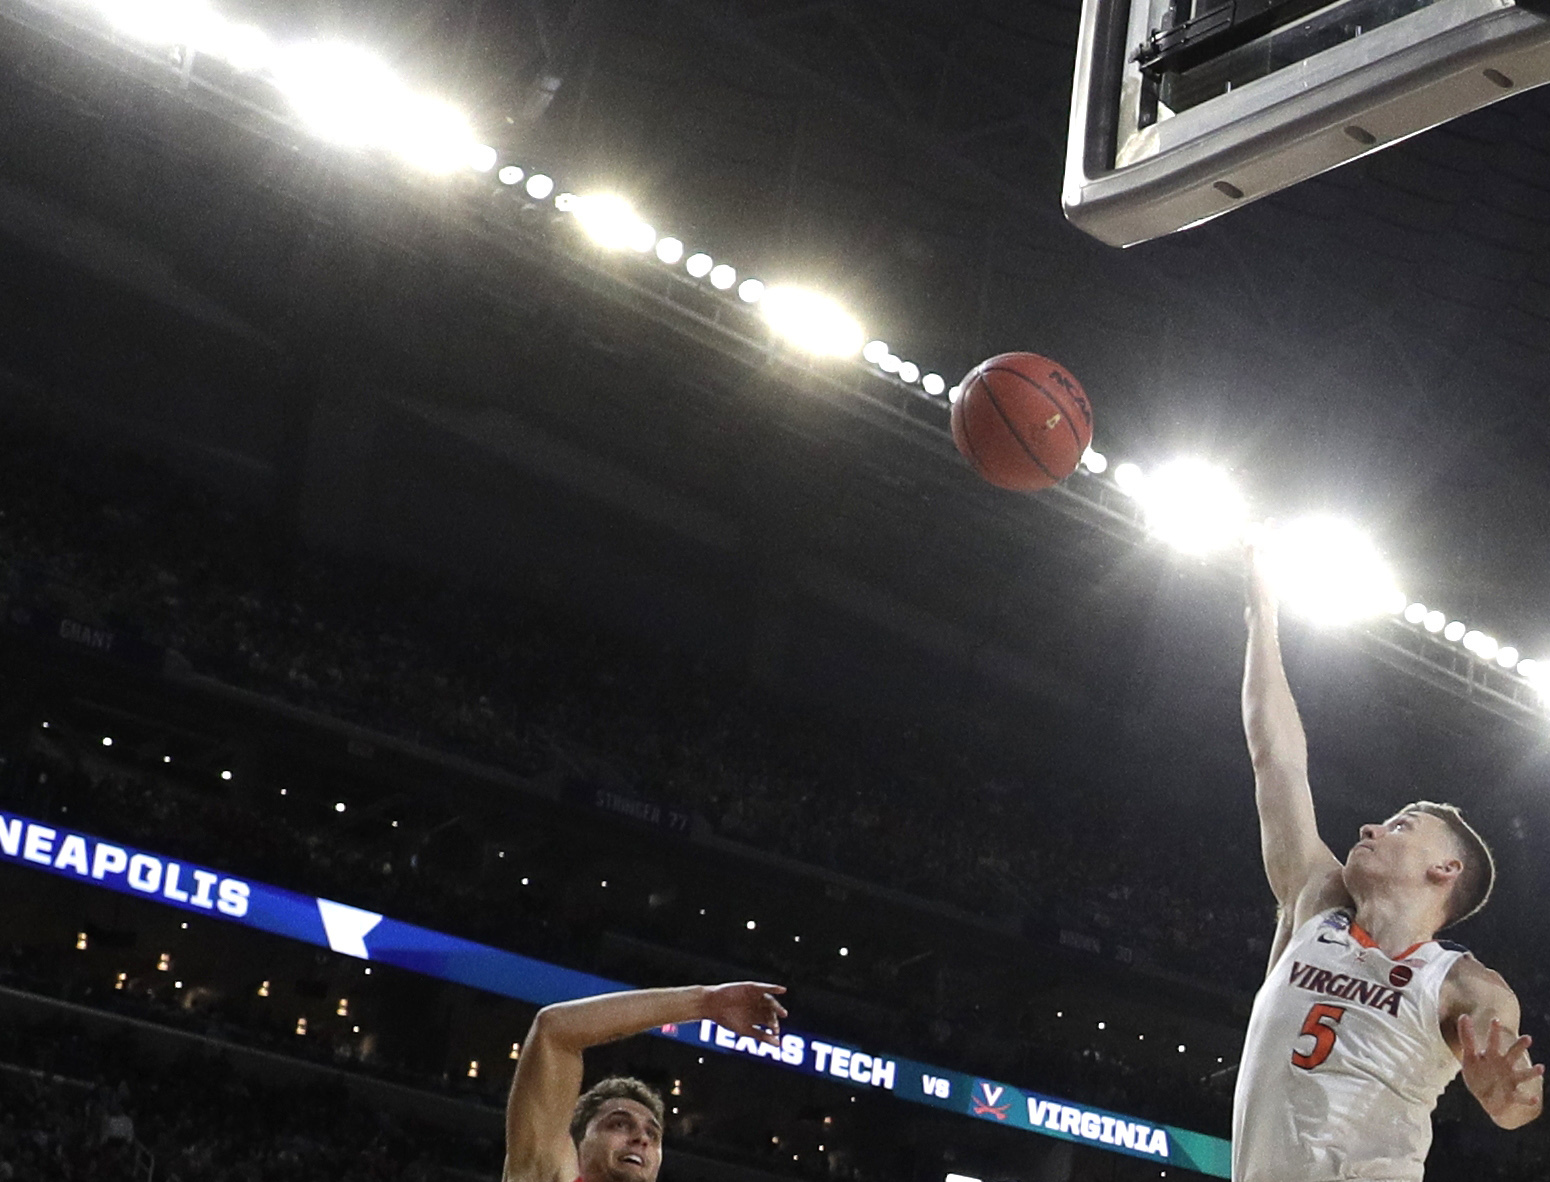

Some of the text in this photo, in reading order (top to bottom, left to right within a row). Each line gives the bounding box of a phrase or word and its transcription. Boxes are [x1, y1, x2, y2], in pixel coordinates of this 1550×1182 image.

[1289, 961, 1403, 1018] VIRGINIA
[811, 1041, 896, 1089] TECH
[1291, 1003, 1347, 1071] 5
[1027, 1097, 1169, 1157] VIRGINIA
